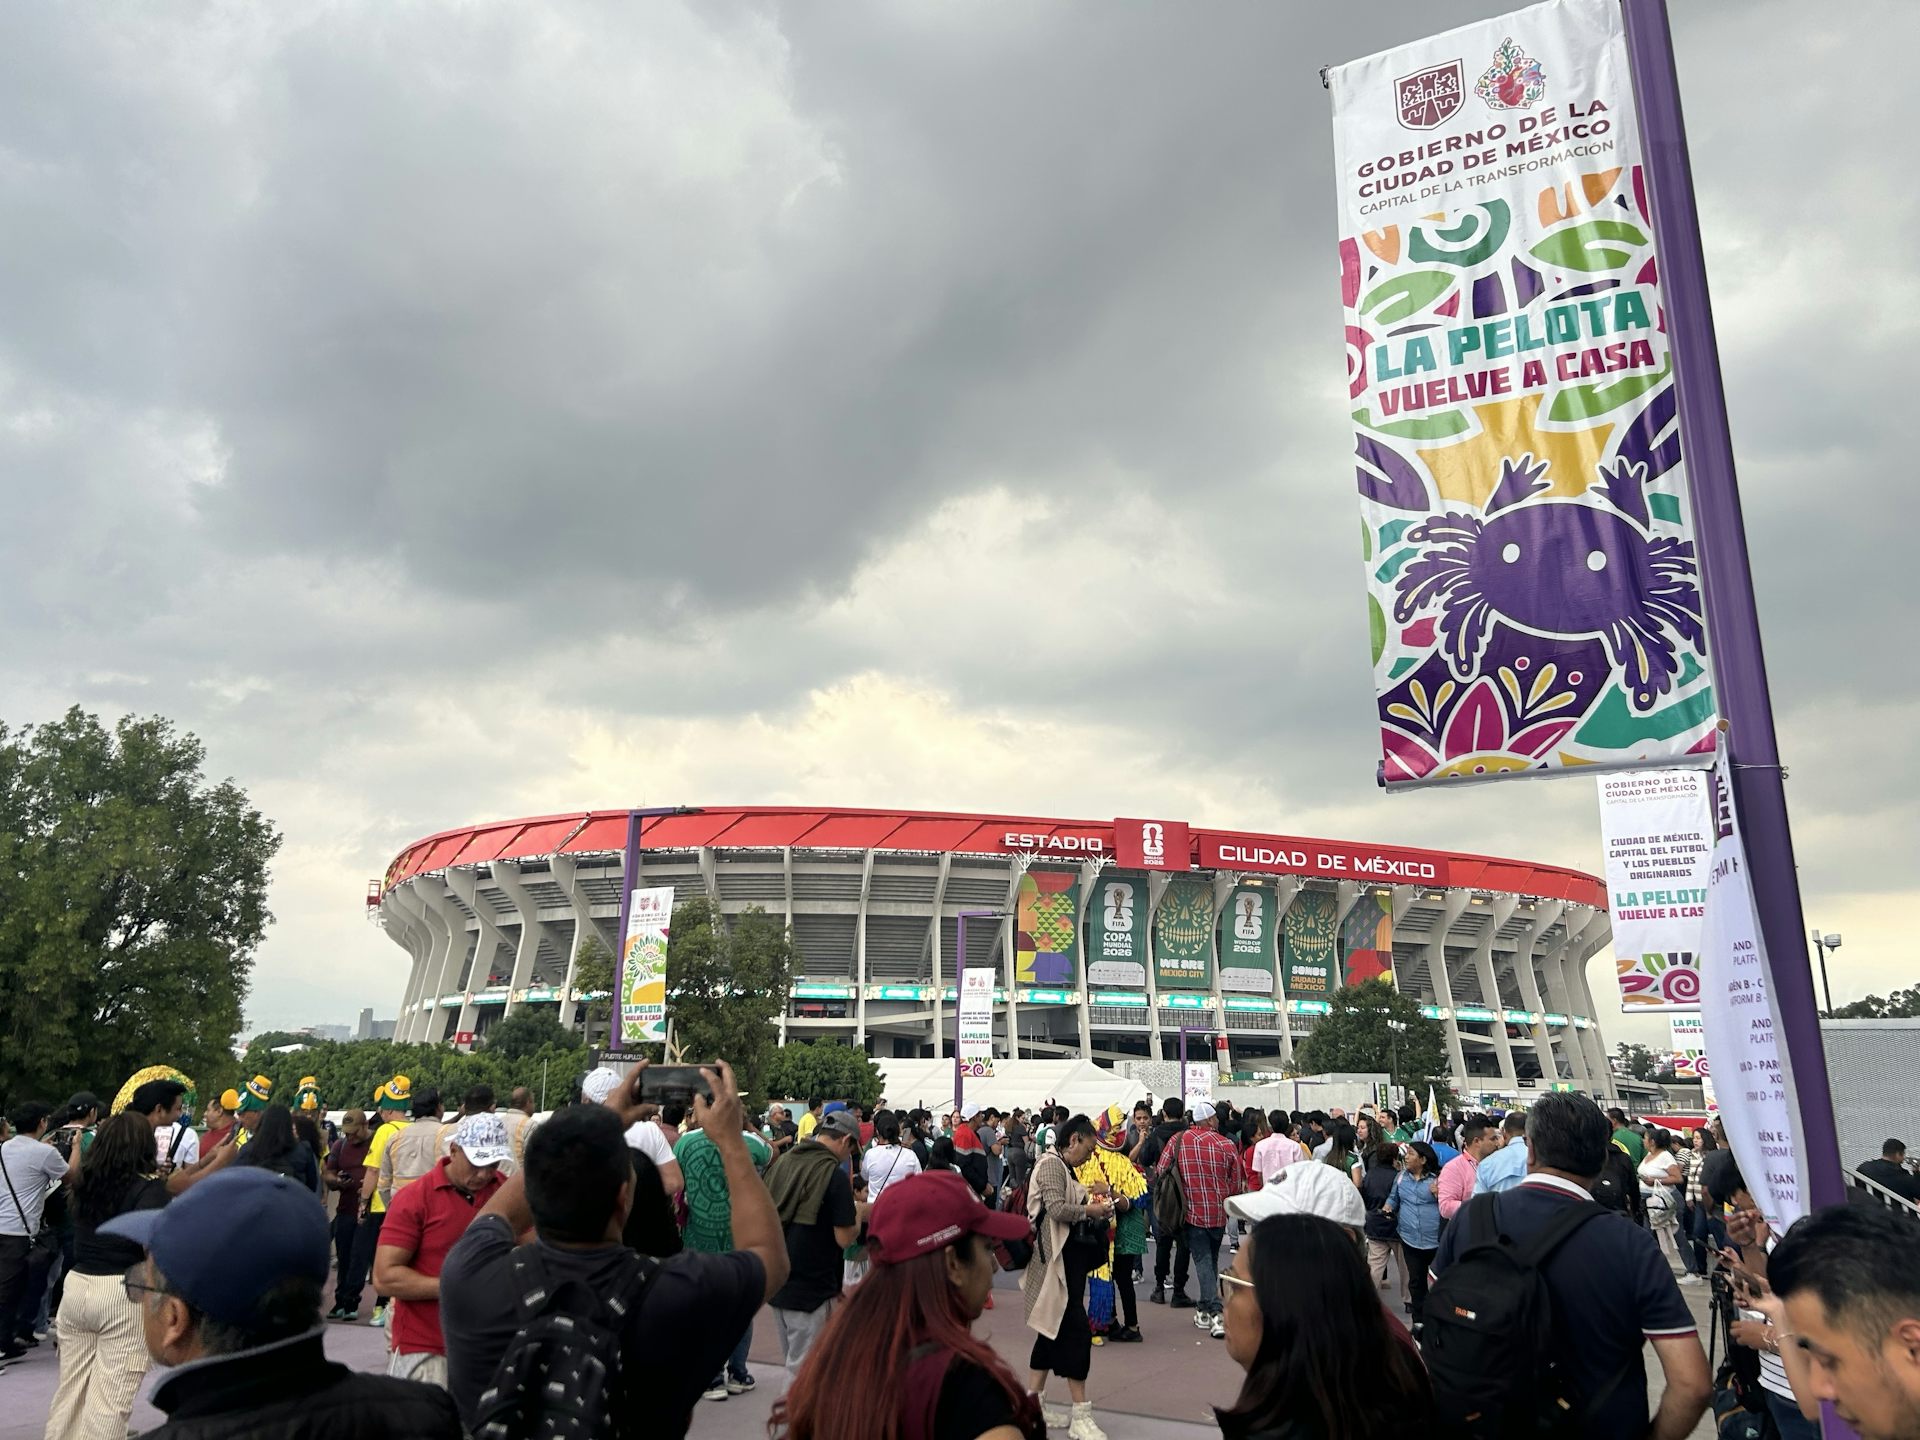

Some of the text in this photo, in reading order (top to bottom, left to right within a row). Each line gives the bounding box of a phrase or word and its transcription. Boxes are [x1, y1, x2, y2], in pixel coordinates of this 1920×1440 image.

[1357, 99, 1608, 178] GOBIERNO DE LA
[1358, 119, 1611, 198] CIUDAD DE MÉXICO
[1359, 139, 1614, 216] CAPITAL DE LA TRANSFORMACIÓN
[1375, 290, 1651, 382] LA PELOTA
[1378, 339, 1656, 416] VUELVE A CASA
[1605, 779, 1660, 789] GOBIERNO
[1605, 784, 1697, 798] CIUDAD DE MÉXICO
[1646, 792, 1698, 802] TRANSFORMACIÓN
[1005, 832, 1103, 851] ESTADIO
[1611, 836, 1645, 846] CIUDAD
[1648, 835, 1660, 843] DE
[1609, 844, 1708, 858] CAPITAL DEL FUTBOL
[1219, 845, 1435, 879] CIUDAD DE MÉXICO
[1632, 859, 1650, 868] LOS
[1652, 856, 1696, 866] PUEBLOS
[1630, 869, 1692, 880] ORIGINARIOS
[1616, 892, 1639, 907] LA
[1618, 906, 1704, 921] VUELVE A CAS
[1103, 932, 1132, 942] COPA
[1103, 941, 1132, 949] MUNDIAL
[1233, 945, 1261, 953] 2026
[1733, 940, 1752, 951] AND
[1103, 948, 1132, 956] 2026
[1160, 958, 1179, 968] WE
[1733, 954, 1758, 965] PLATF
[1291, 965, 1327, 976] SOMOS
[1290, 975, 1316, 983] CIUDAD
[1290, 982, 1325, 991] MÉXICO
[635, 1005, 662, 1013] PELOTA
[1751, 1019, 1772, 1029] AND
[1750, 1033, 1774, 1043] PLATF
[1759, 1060, 1780, 1070] PAR
[1774, 1090, 1785, 1101] PA
